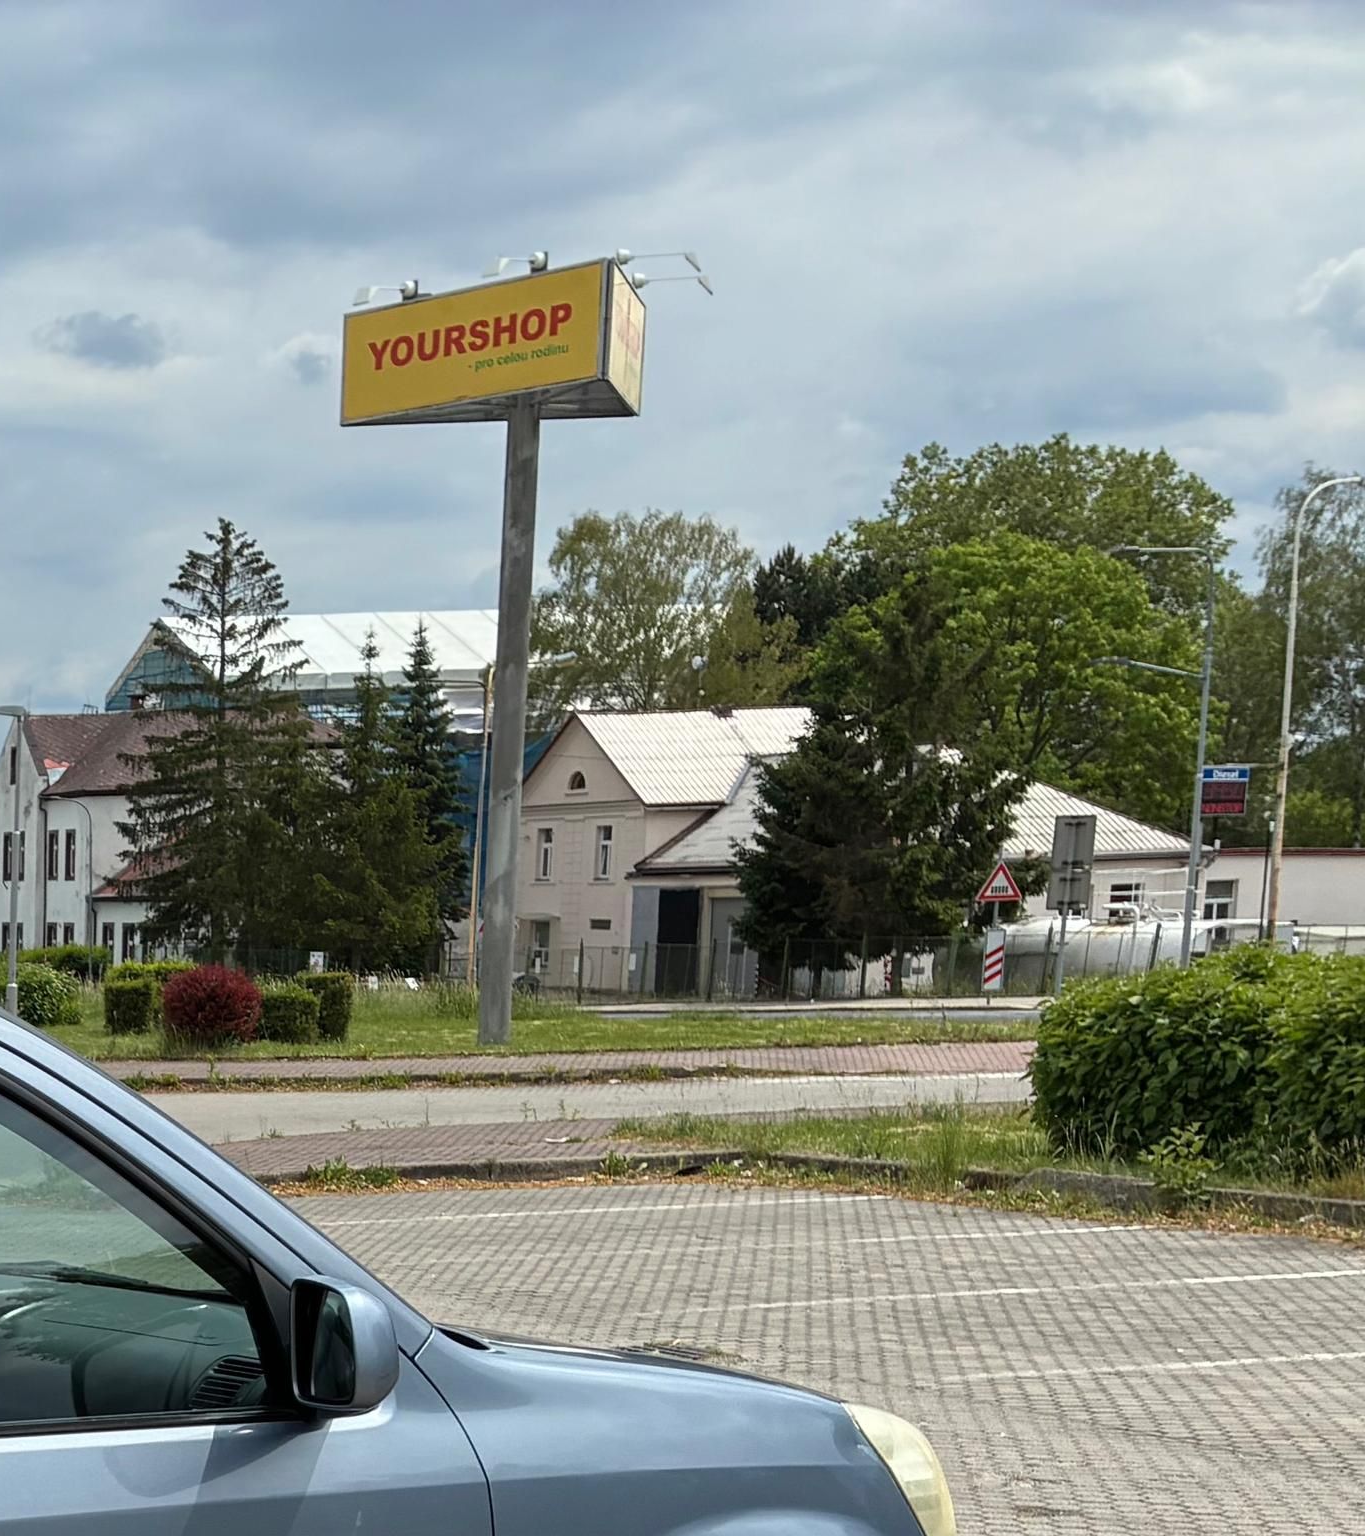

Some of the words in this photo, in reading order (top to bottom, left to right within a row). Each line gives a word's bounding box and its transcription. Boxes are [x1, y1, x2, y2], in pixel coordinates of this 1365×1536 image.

[368, 303, 573, 371] YOURSHOP
[474, 358, 495, 373] pro
[496, 352, 528, 366] celou
[531, 344, 570, 360] rodinu
